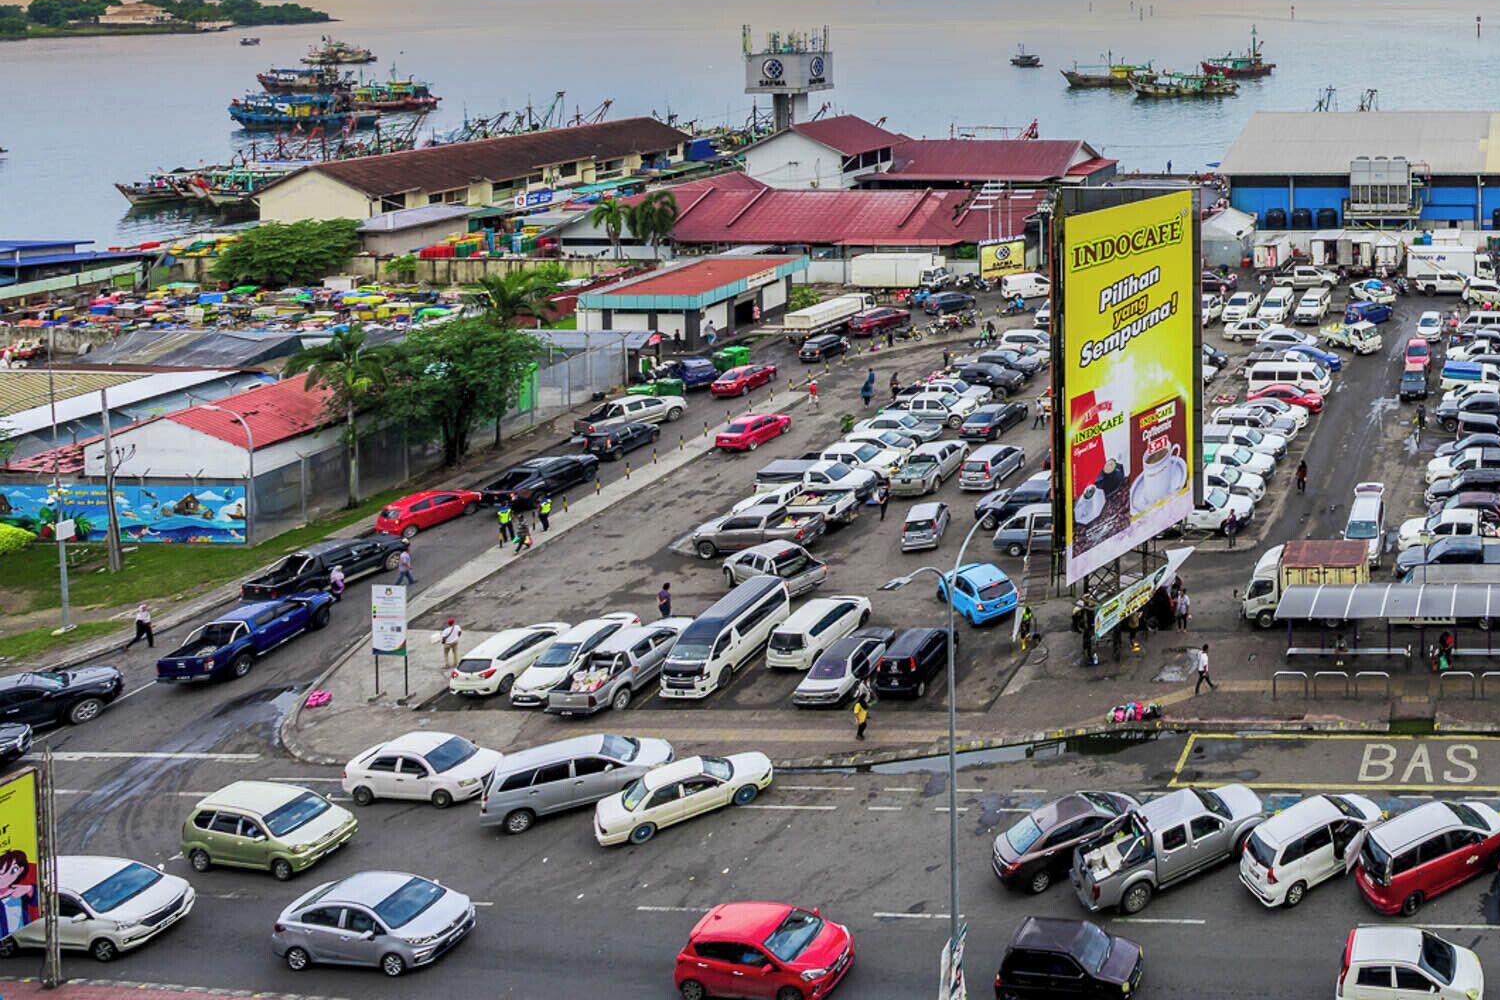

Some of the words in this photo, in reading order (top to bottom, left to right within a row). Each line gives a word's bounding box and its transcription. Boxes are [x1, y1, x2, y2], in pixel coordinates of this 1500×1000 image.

[1073, 217, 1181, 268] INDOCAFÉ
[1099, 266, 1160, 314] Pilihan
[1113, 294, 1148, 329] yang
[1079, 291, 1178, 368] Sempurna!
[1357, 743, 1479, 783] BAS
